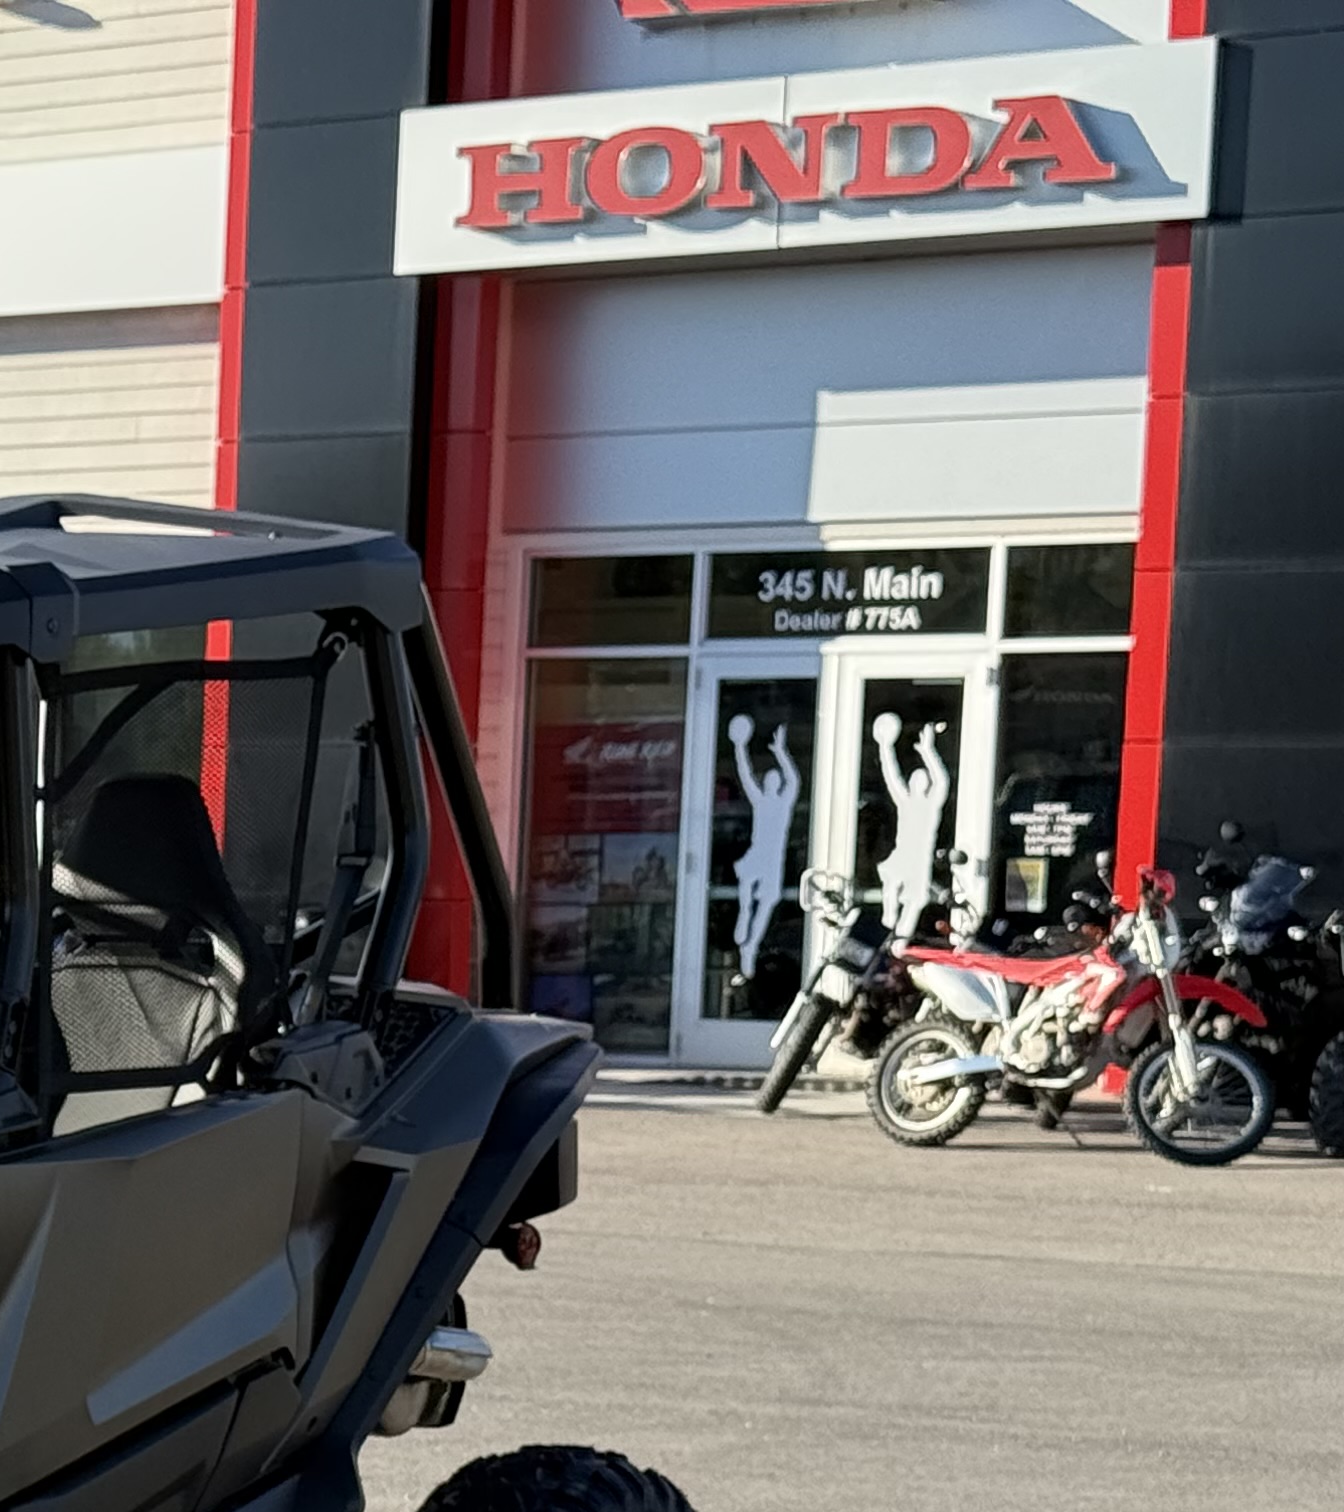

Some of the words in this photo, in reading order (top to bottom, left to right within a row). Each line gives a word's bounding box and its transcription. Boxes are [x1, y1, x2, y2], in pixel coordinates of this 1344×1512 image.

[454, 94, 1117, 229] HONDA
[757, 568, 815, 602] 345
[820, 567, 858, 601] N.
[862, 564, 945, 601] Main
[773, 608, 843, 632] Dealer
[844, 604, 923, 631] #775A
